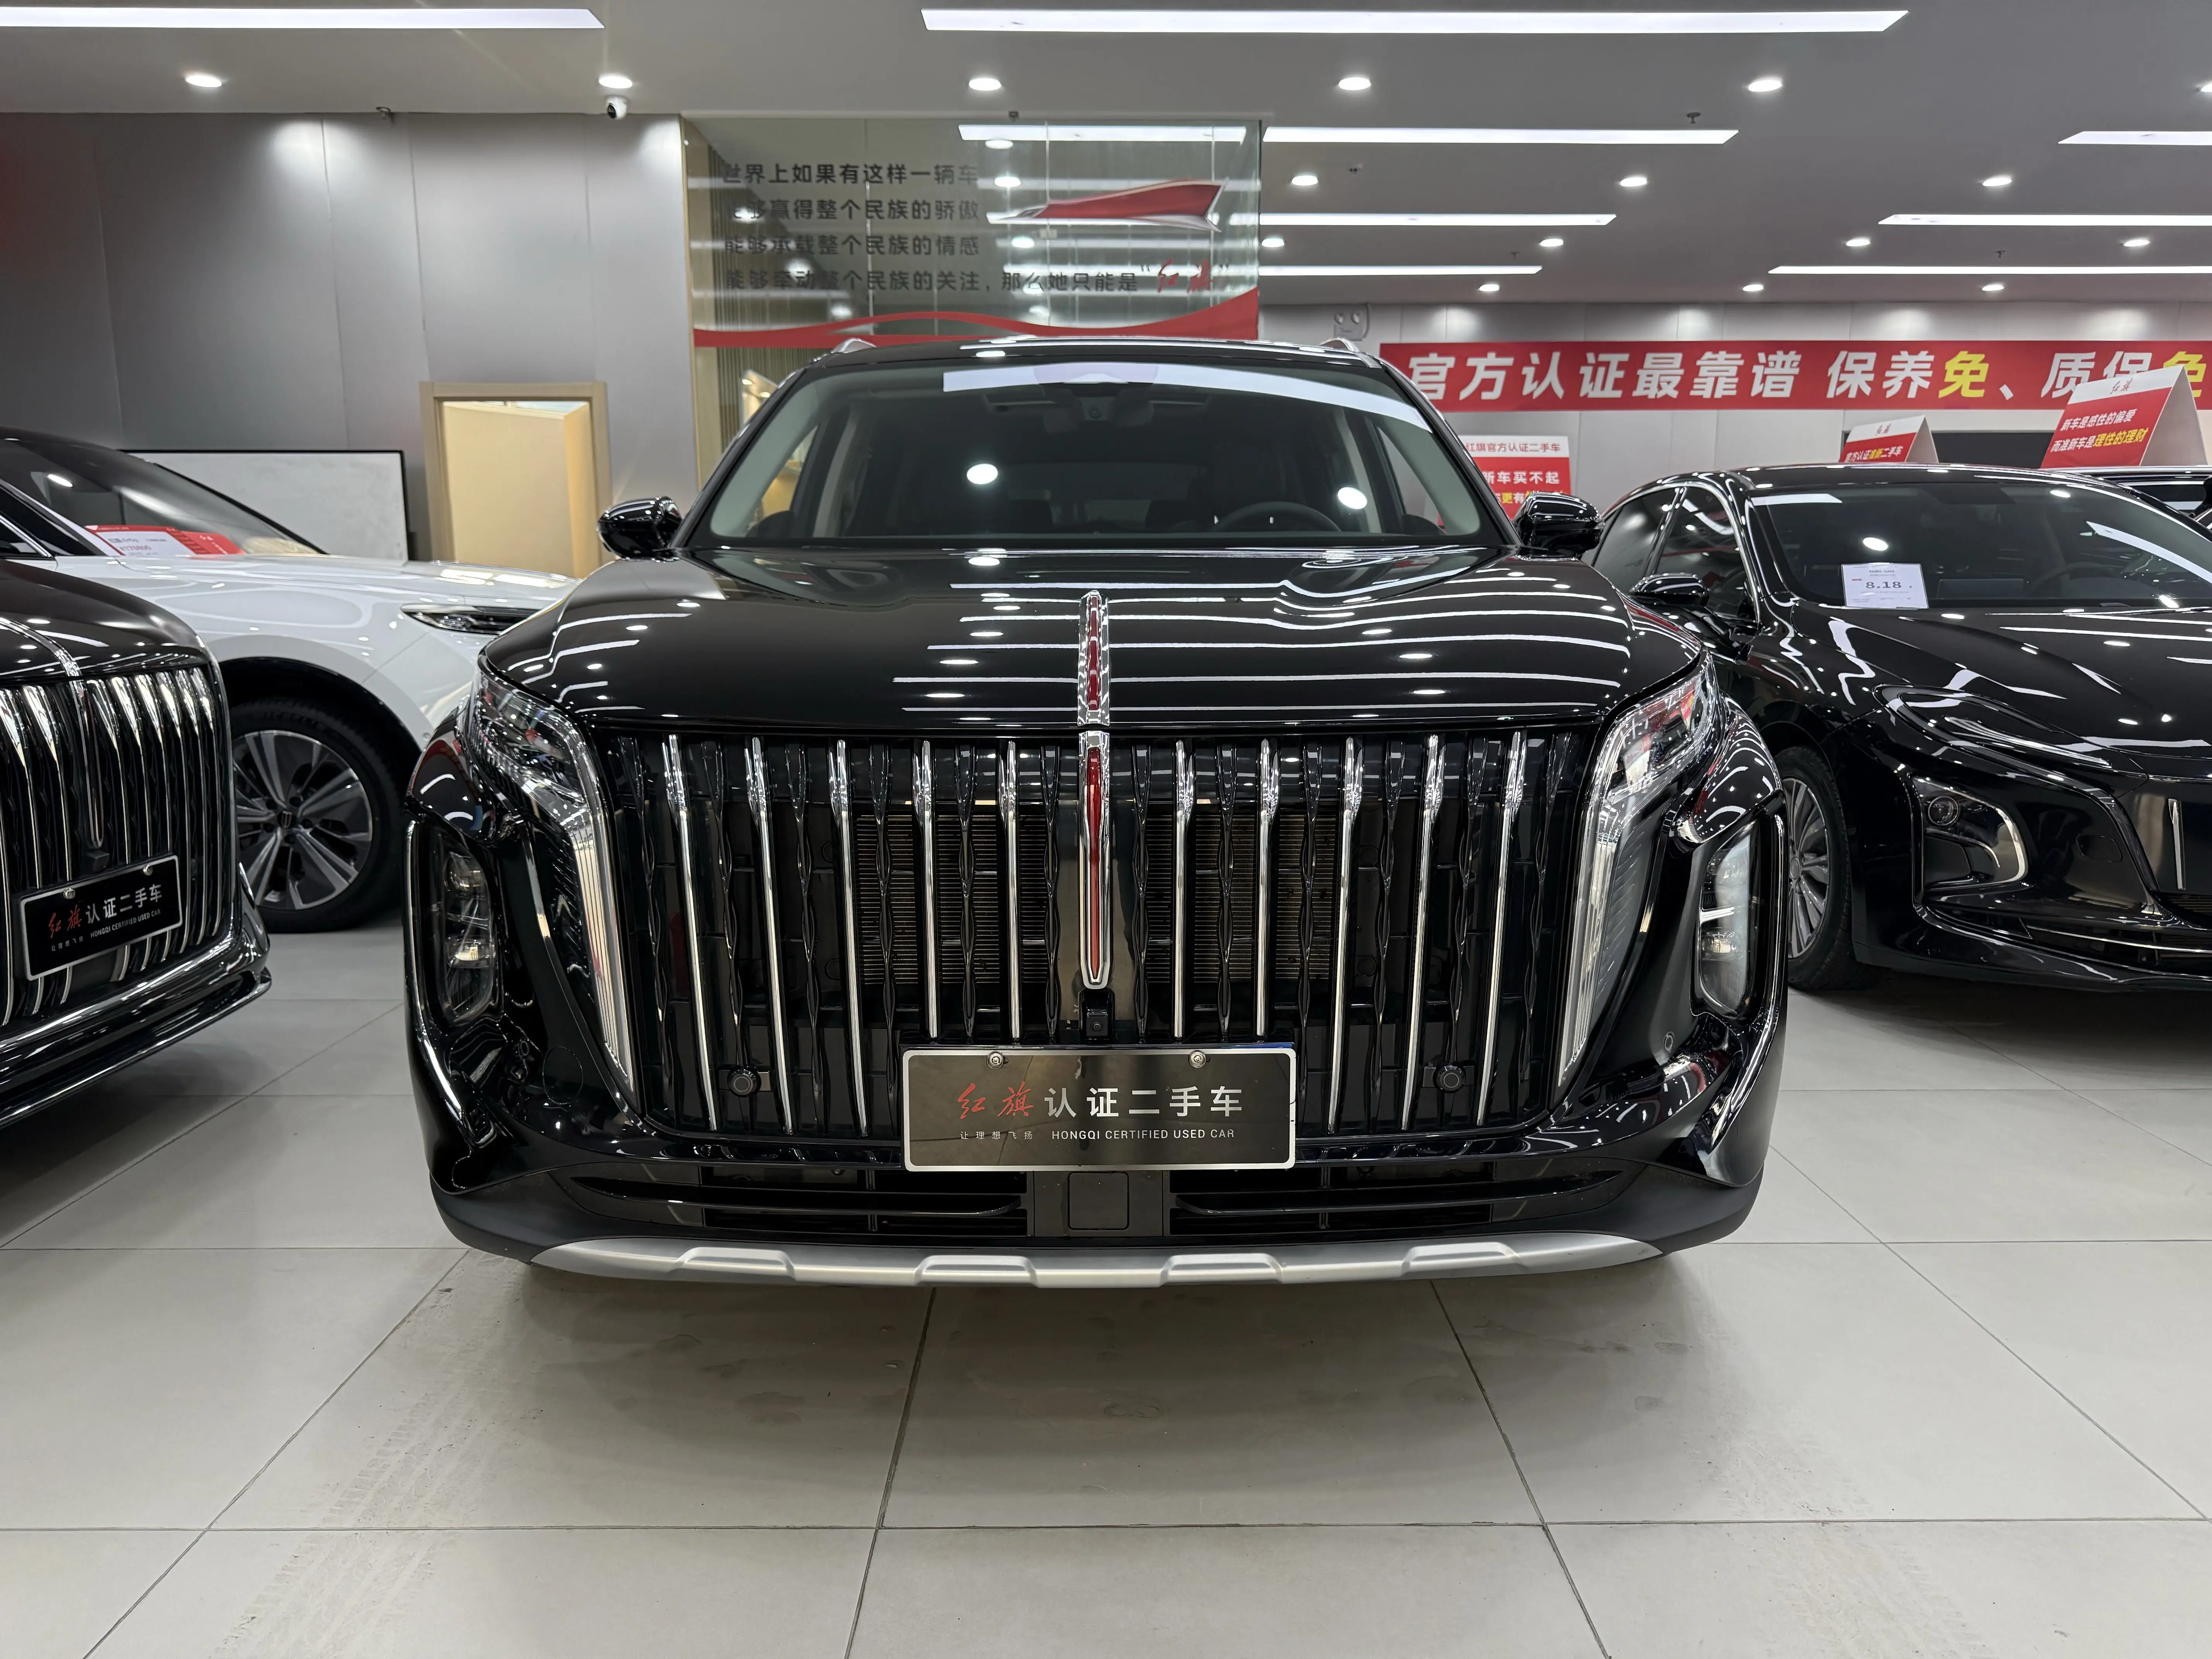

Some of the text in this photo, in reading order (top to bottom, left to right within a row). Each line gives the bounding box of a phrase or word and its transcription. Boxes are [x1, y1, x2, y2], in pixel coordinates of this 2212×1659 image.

[723, 163, 978, 185] 世界上如果有这样一辆车
[1408, 351, 1801, 401] 官方认证最靠谱
[2110, 378, 2133, 395] 红旗
[2060, 408, 2138, 431] 新车是感性的偏爱
[1465, 442, 1561, 453] 红旗官方认证二手车
[2050, 427, 2149, 453] 而准新车是理性的理财
[90, 908, 161, 939] HONGQI CERTIFIED USED CAR
[960, 1130, 1033, 1140] 让理想飞扬
[1052, 1129, 1235, 1140] HONGQI CERTIFIED USED CAR
